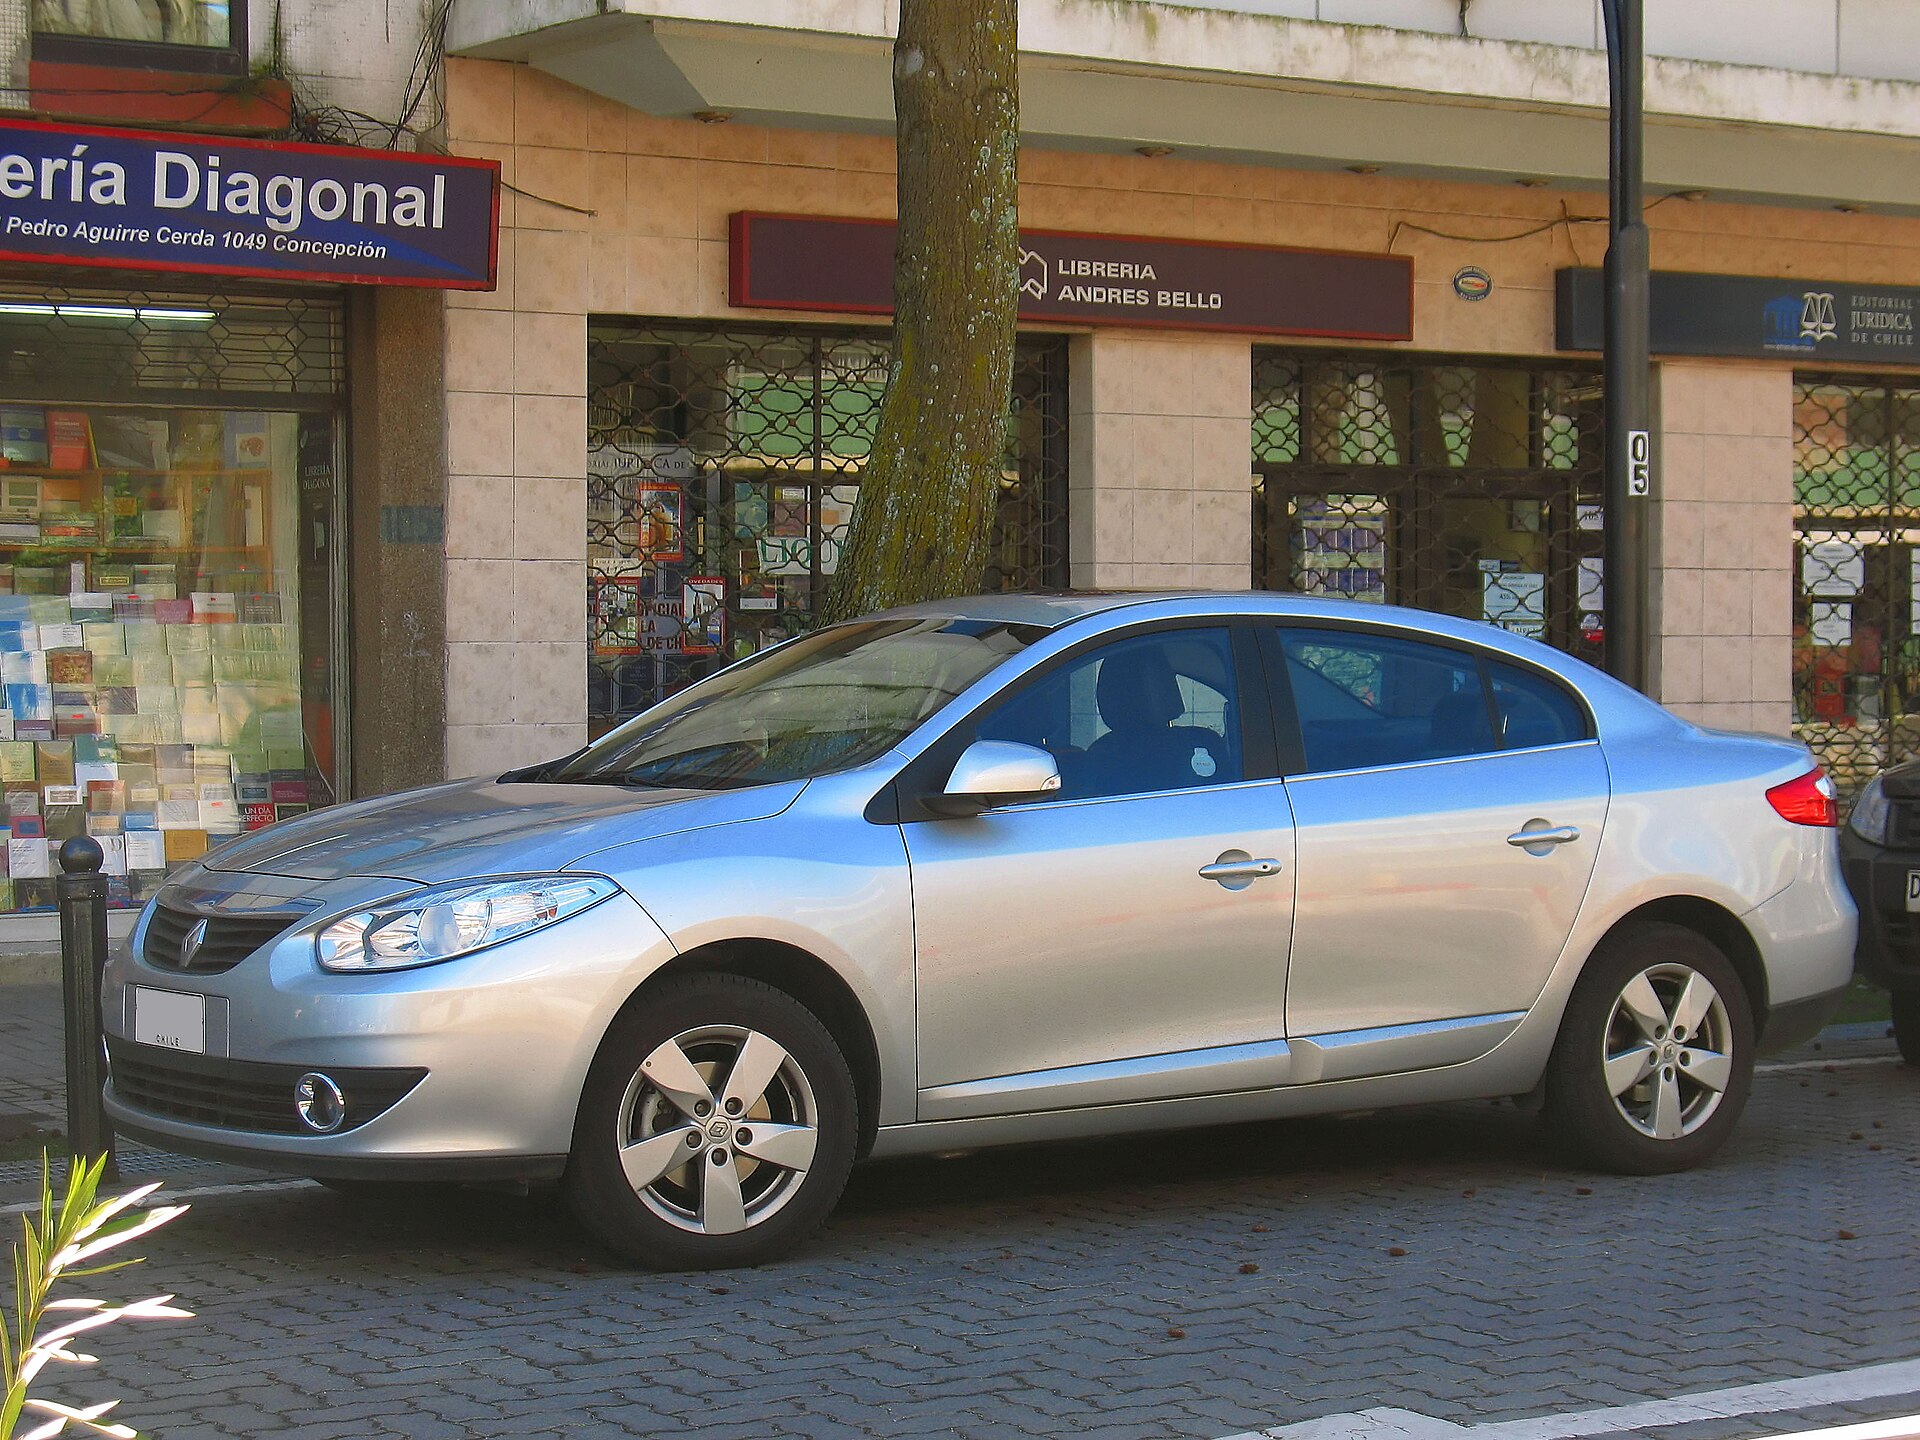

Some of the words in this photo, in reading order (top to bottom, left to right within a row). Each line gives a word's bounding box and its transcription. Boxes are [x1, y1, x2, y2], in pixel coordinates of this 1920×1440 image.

[0, 144, 126, 206] ería
[154, 151, 446, 233] Diagonal
[6, 216, 69, 238] Pedro
[73, 221, 150, 244] Aguirre
[156, 226, 215, 247] Cerda
[222, 230, 267, 250] 1049
[272, 234, 387, 259] Concepción
[1058, 259, 1157, 280] LIBRERIA
[1058, 285, 1150, 305] ANDRES
[1157, 290, 1222, 309] BELLO
[1852, 295, 1913, 309] EDITORIAL
[1851, 311, 1913, 331] JURIDICA
[1852, 332, 1868, 344] DE
[1873, 333, 1914, 345] CHILE
[1632, 433, 1648, 494] 05
